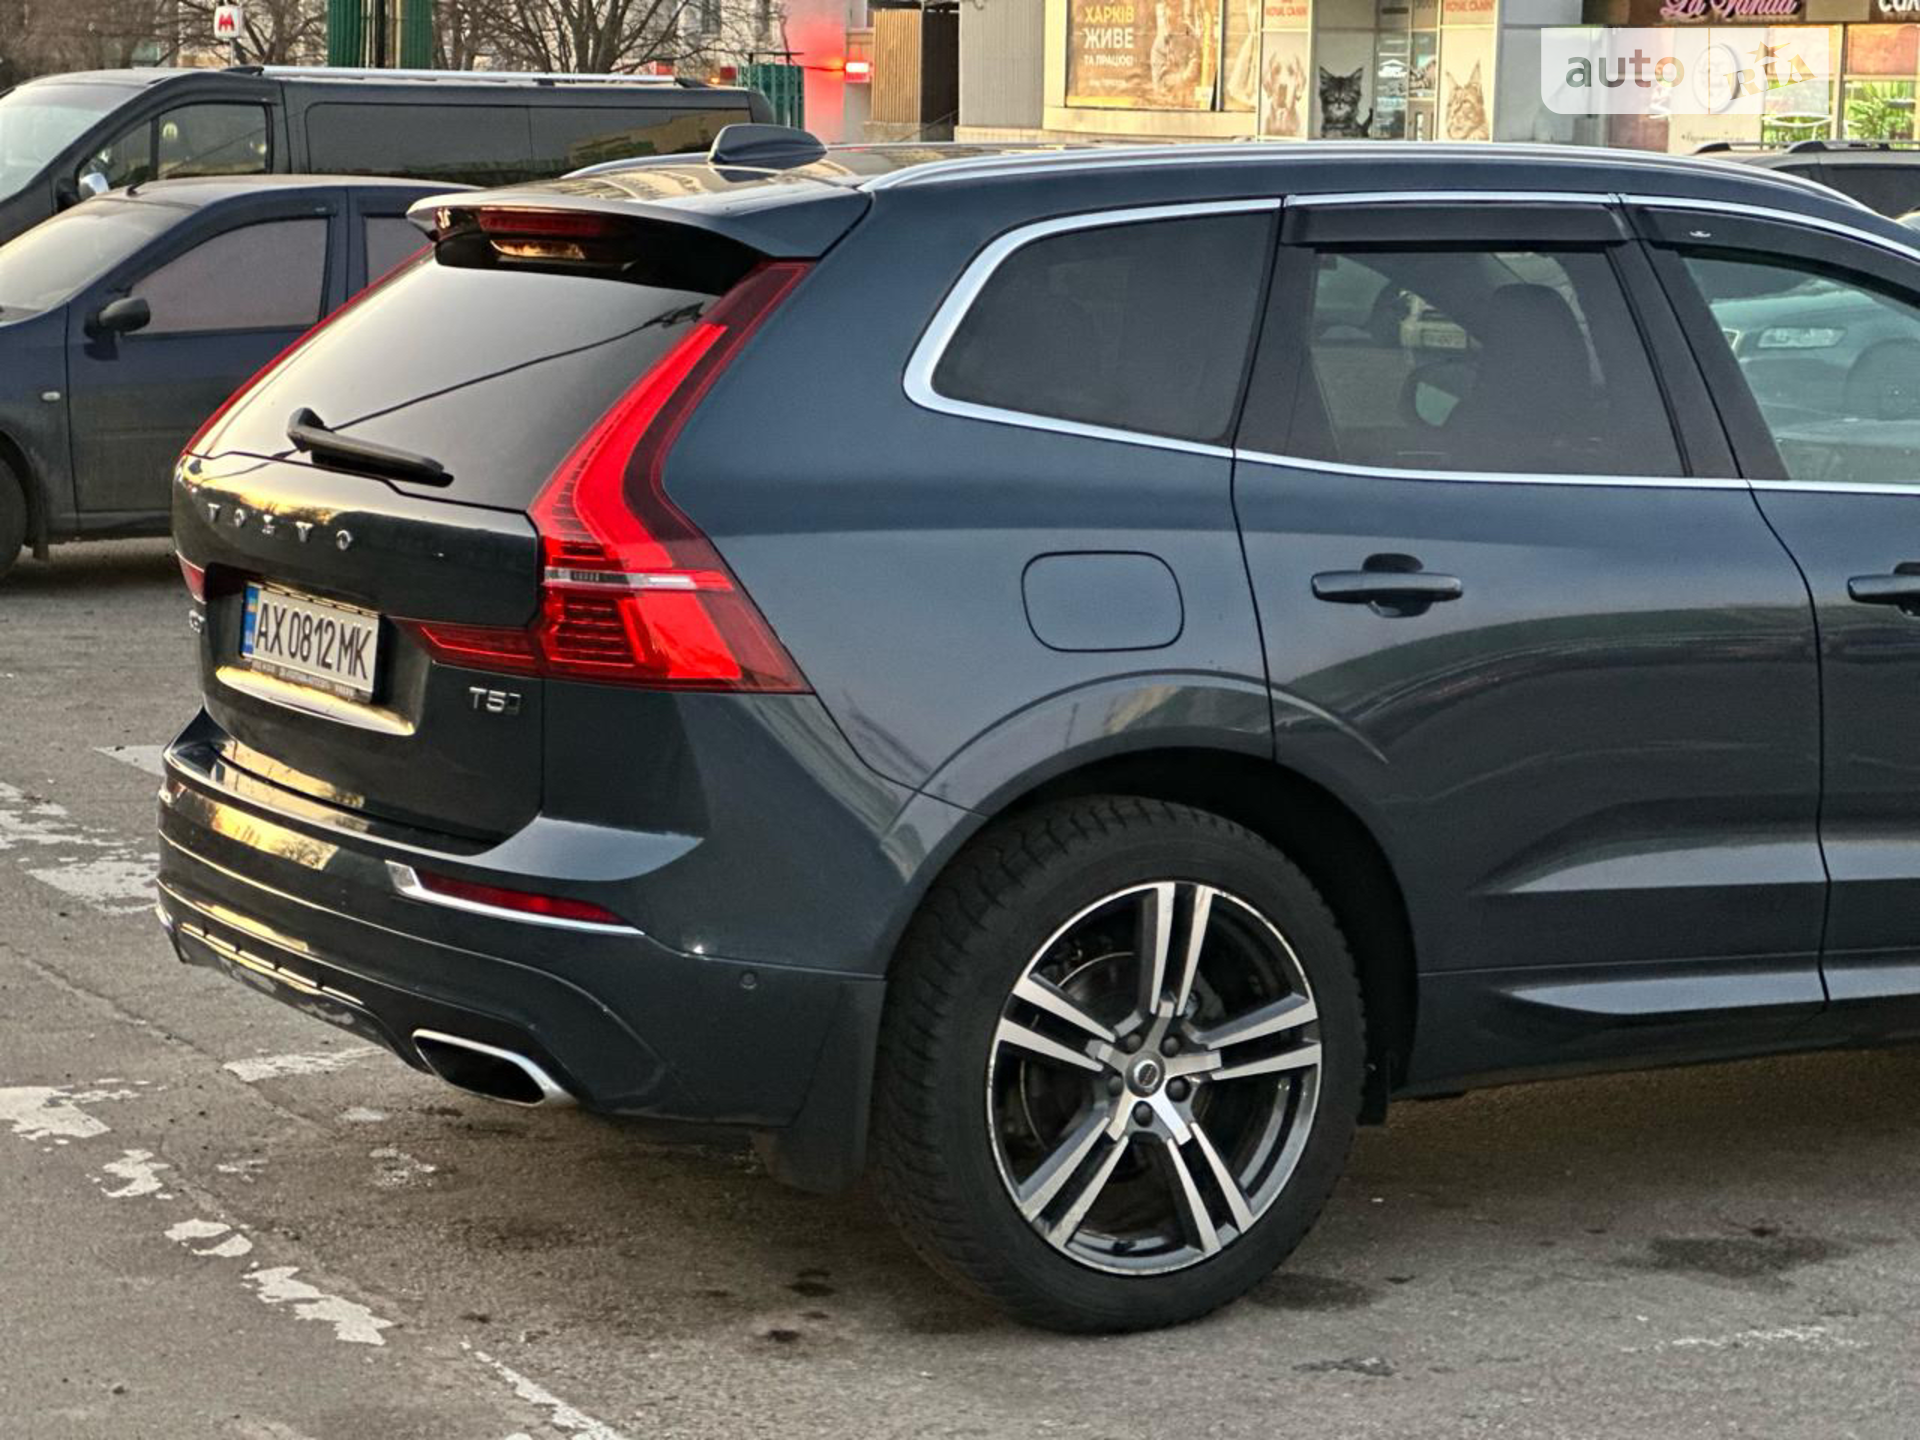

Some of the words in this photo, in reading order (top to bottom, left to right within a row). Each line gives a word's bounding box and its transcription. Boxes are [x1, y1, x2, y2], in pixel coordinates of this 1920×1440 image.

[1085, 5, 1135, 24] ХАРКІВ
[1083, 27, 1135, 49] ЖИВЕ
[255, 602, 288, 657] AX
[288, 610, 336, 670] 0812
[336, 622, 373, 680] MK
